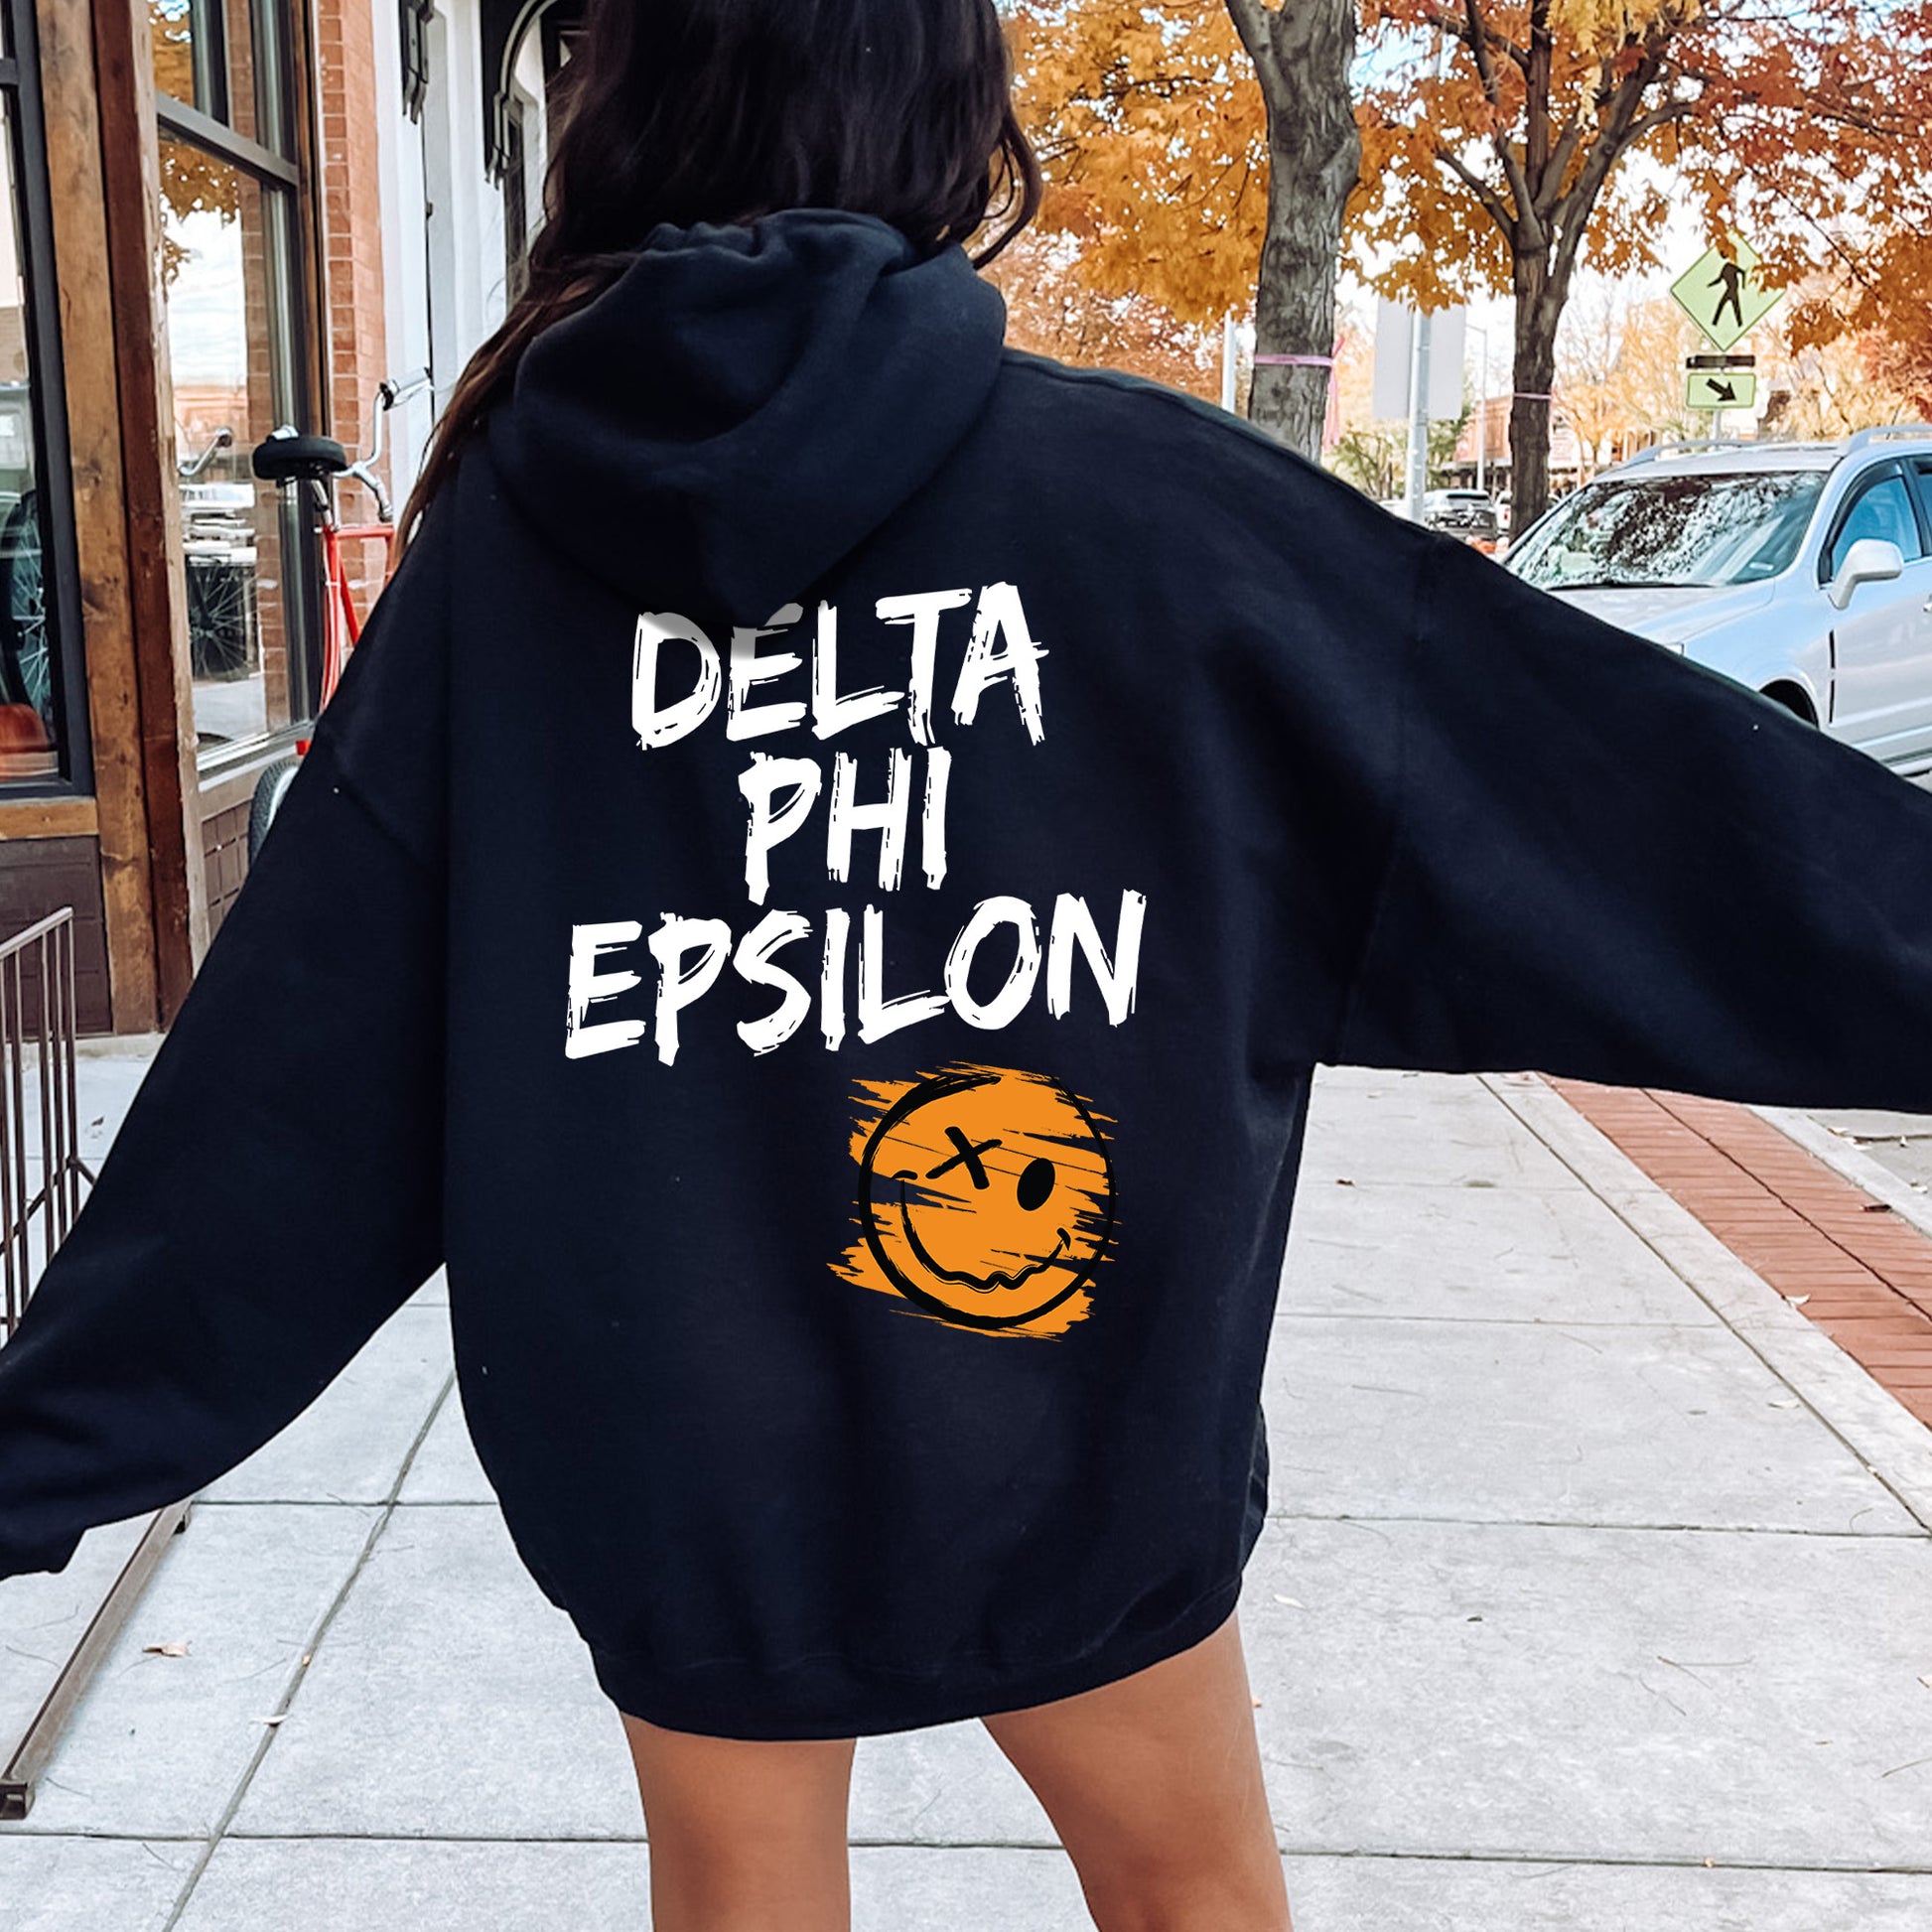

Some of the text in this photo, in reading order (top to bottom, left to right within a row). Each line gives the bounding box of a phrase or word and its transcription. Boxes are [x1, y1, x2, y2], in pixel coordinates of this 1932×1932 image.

[631, 582, 1048, 750] DELTA
[738, 746, 952, 905] PHI
[565, 889, 1147, 1066] EPSILON
